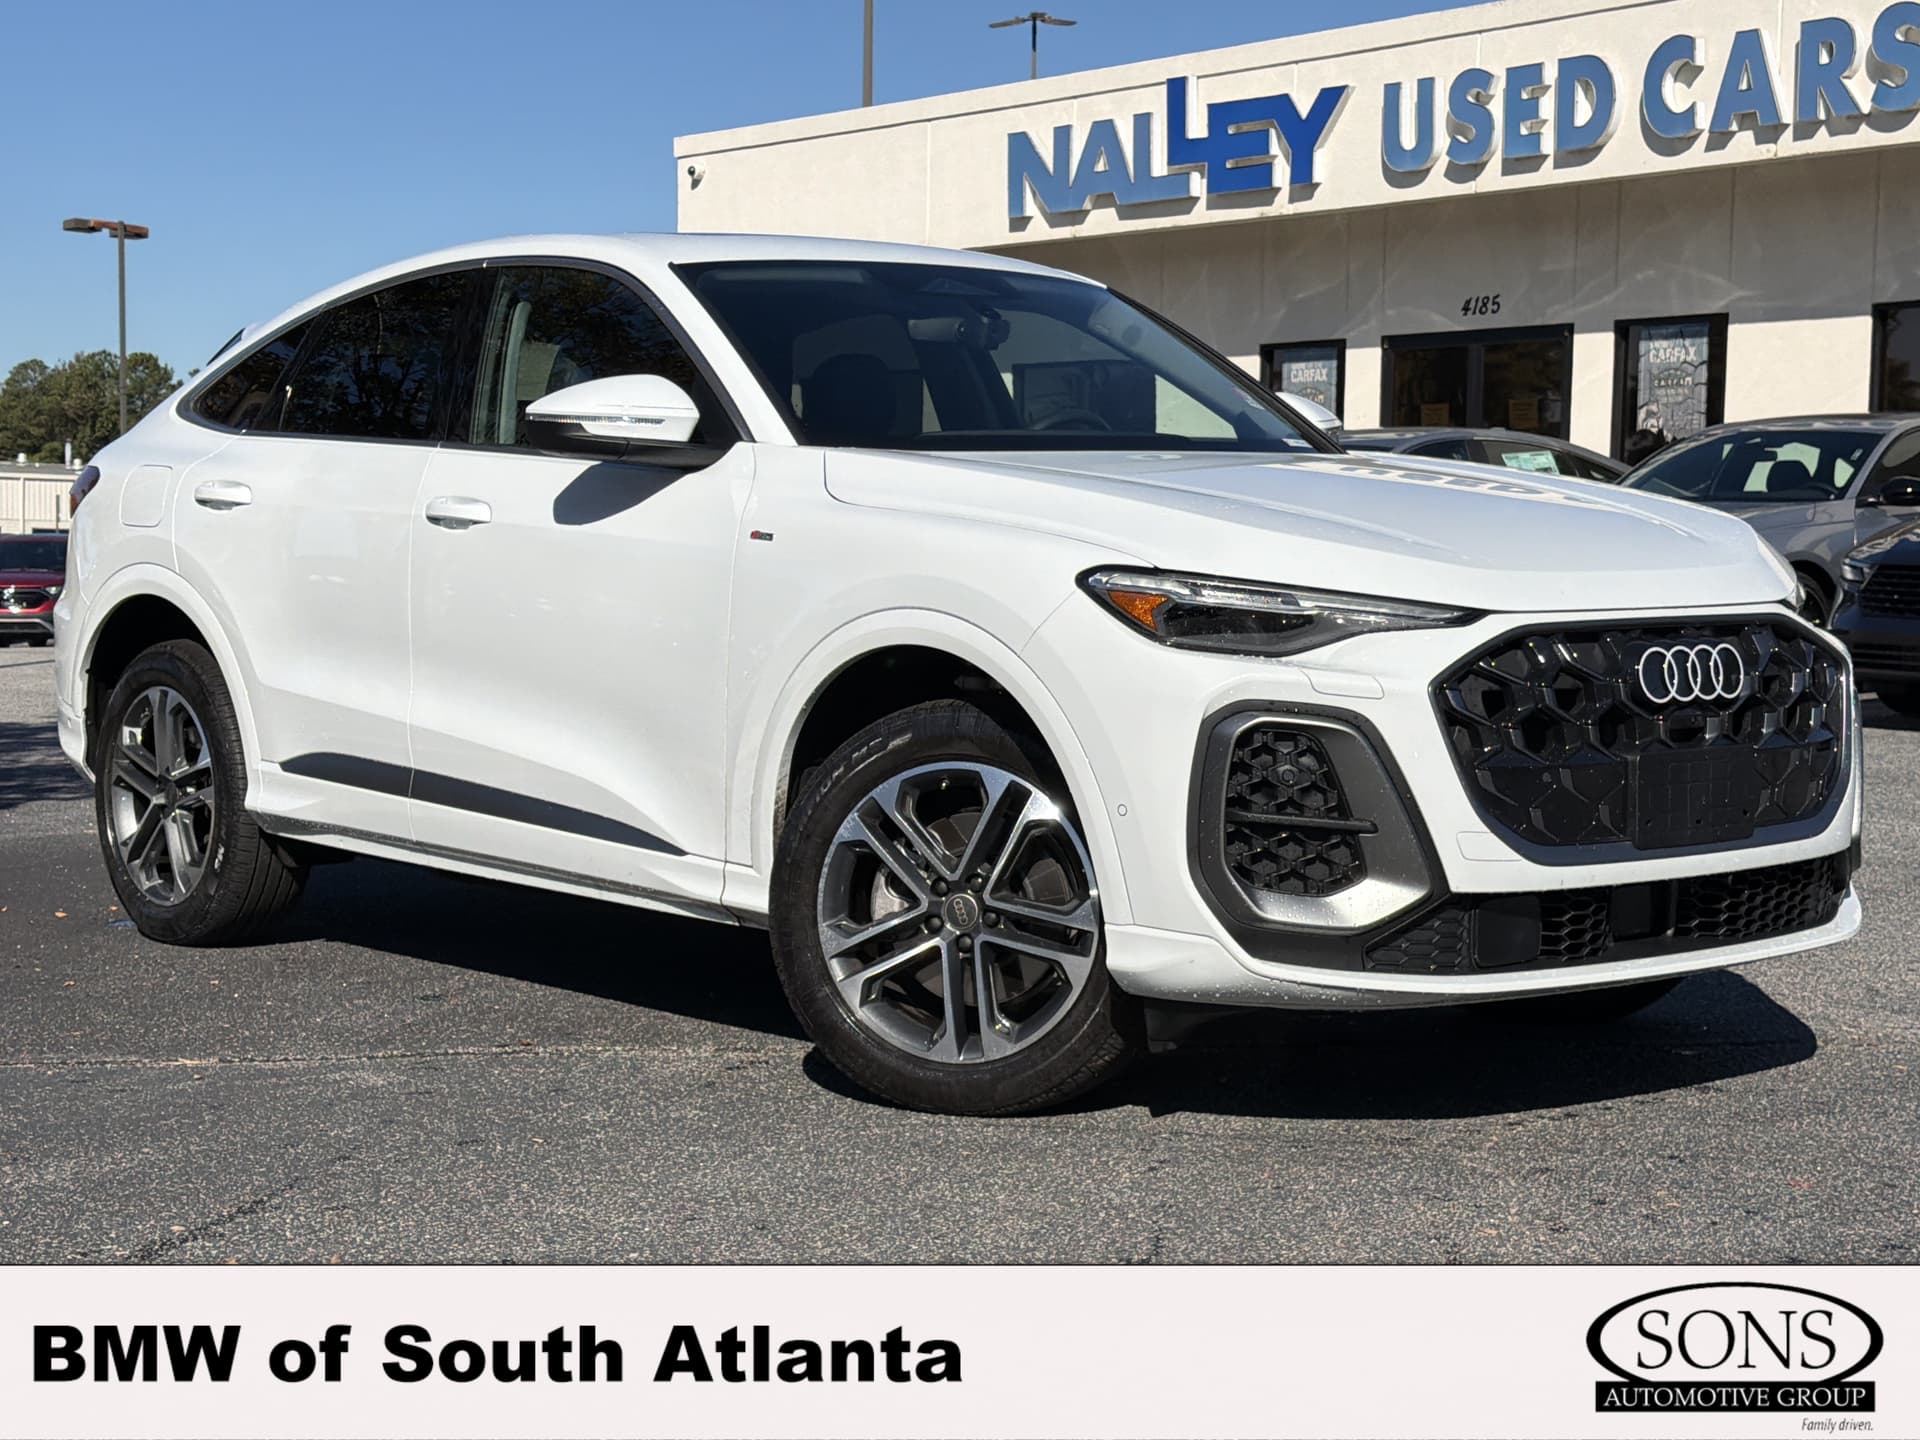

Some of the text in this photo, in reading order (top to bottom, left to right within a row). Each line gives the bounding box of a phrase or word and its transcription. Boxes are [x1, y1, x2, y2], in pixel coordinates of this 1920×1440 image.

[1007, 1, 1920, 220] NALLEY USED CARS
[1461, 294, 1501, 317] 4185
[1290, 367, 1329, 384] CARFAX
